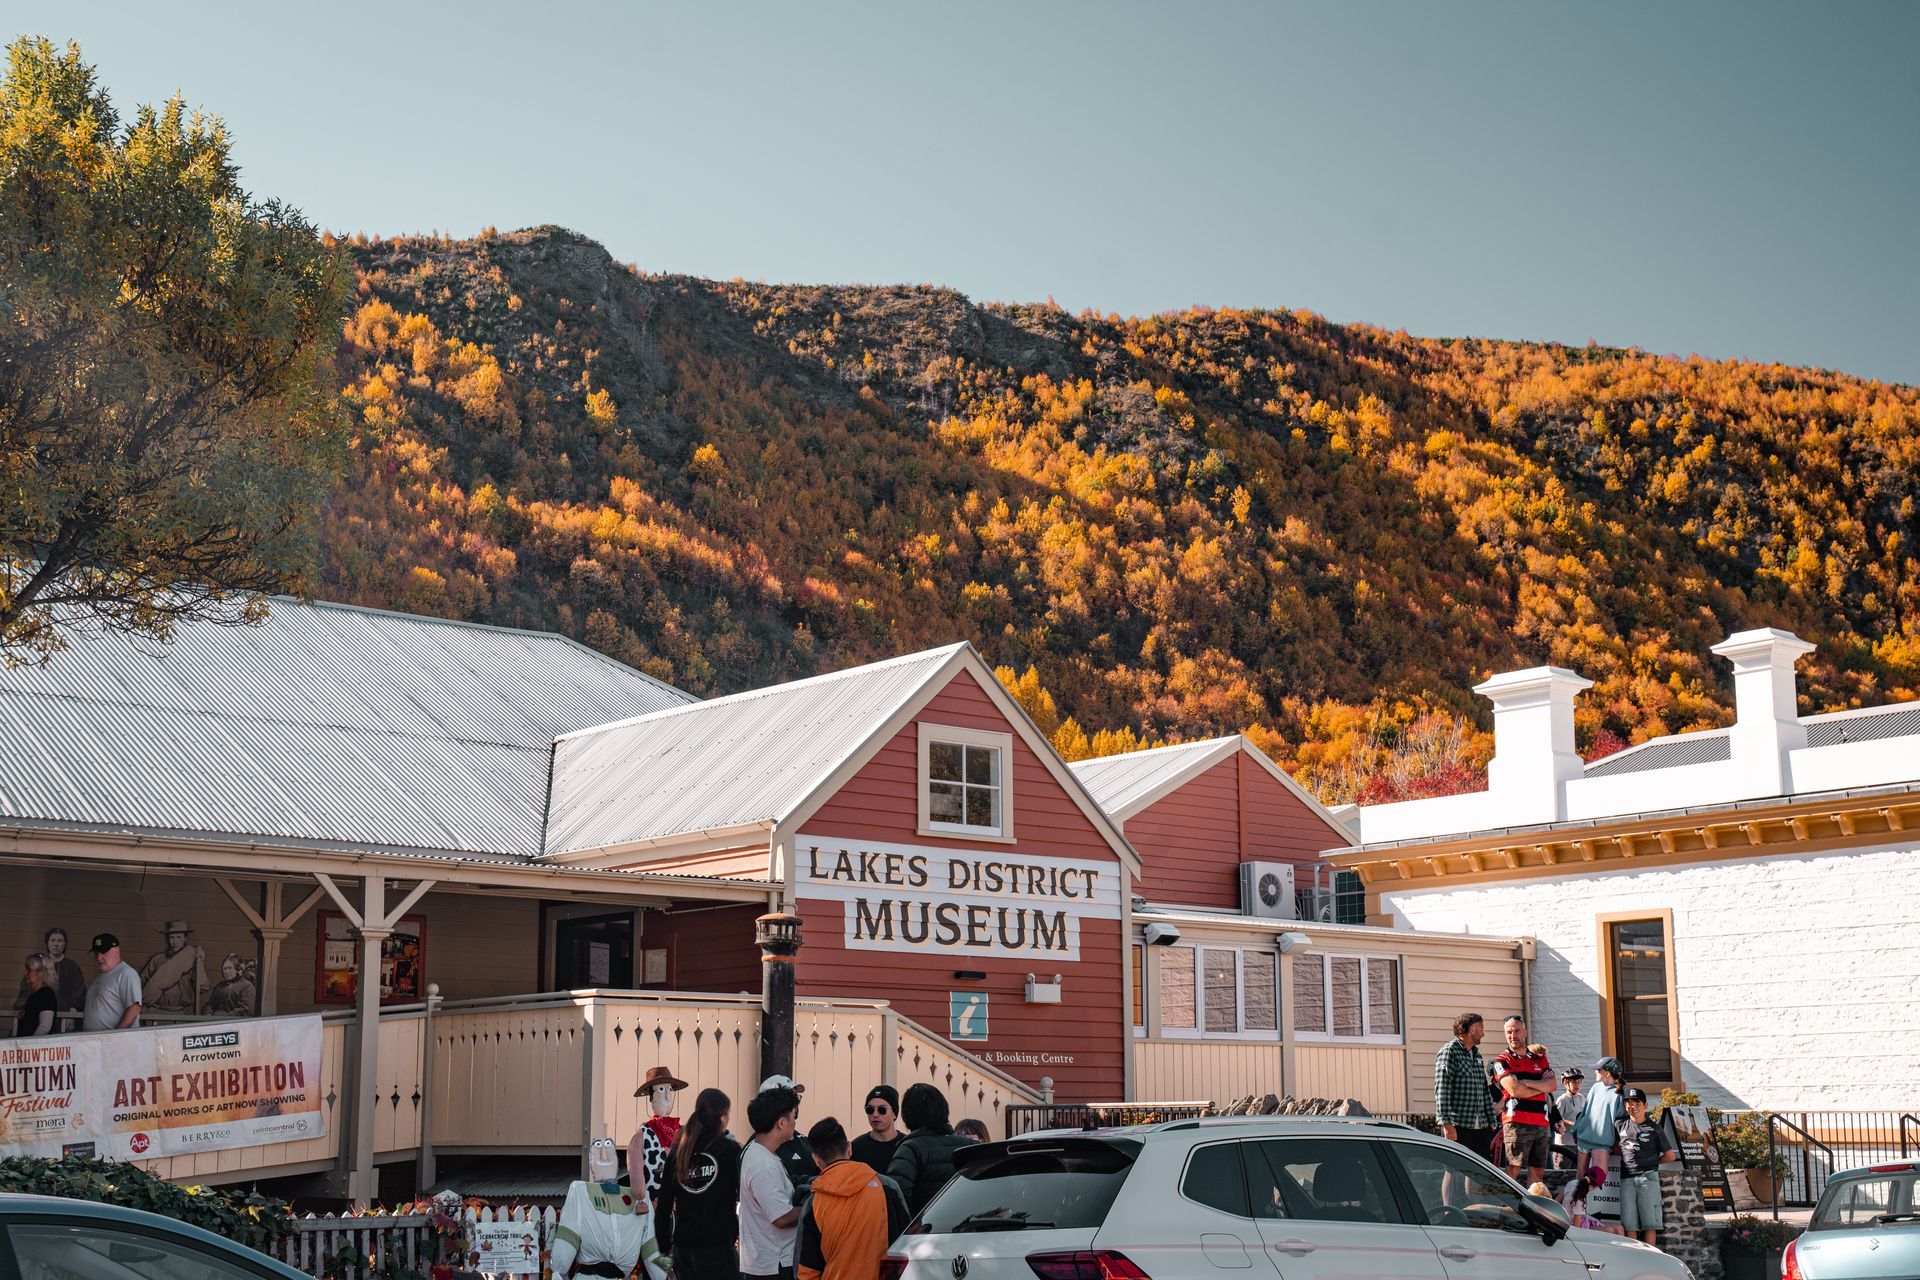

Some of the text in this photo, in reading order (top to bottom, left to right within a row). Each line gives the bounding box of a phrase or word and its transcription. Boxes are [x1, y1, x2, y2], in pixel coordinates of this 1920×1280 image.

[809, 846, 1099, 899] LAKES DISTRICT
[853, 897, 1069, 951] MUSEUM
[185, 1034, 236, 1048] BAYLEYS
[1, 1046, 71, 1064] ARROWTOWN
[181, 1050, 241, 1063] Arrowtown
[985, 1052, 993, 1062] &
[996, 1051, 1038, 1065] Booking
[1041, 1052, 1074, 1063] Centre
[113, 1061, 305, 1108] ART EXHIBITION
[0, 1092, 73, 1118] Festival
[113, 1094, 306, 1122] ORIGINAL WORKS OF ART NOW SHOWING
[36, 1117, 66, 1128] mora
[131, 1137, 149, 1149] Apt
[701, 1166, 715, 1177] TAP
